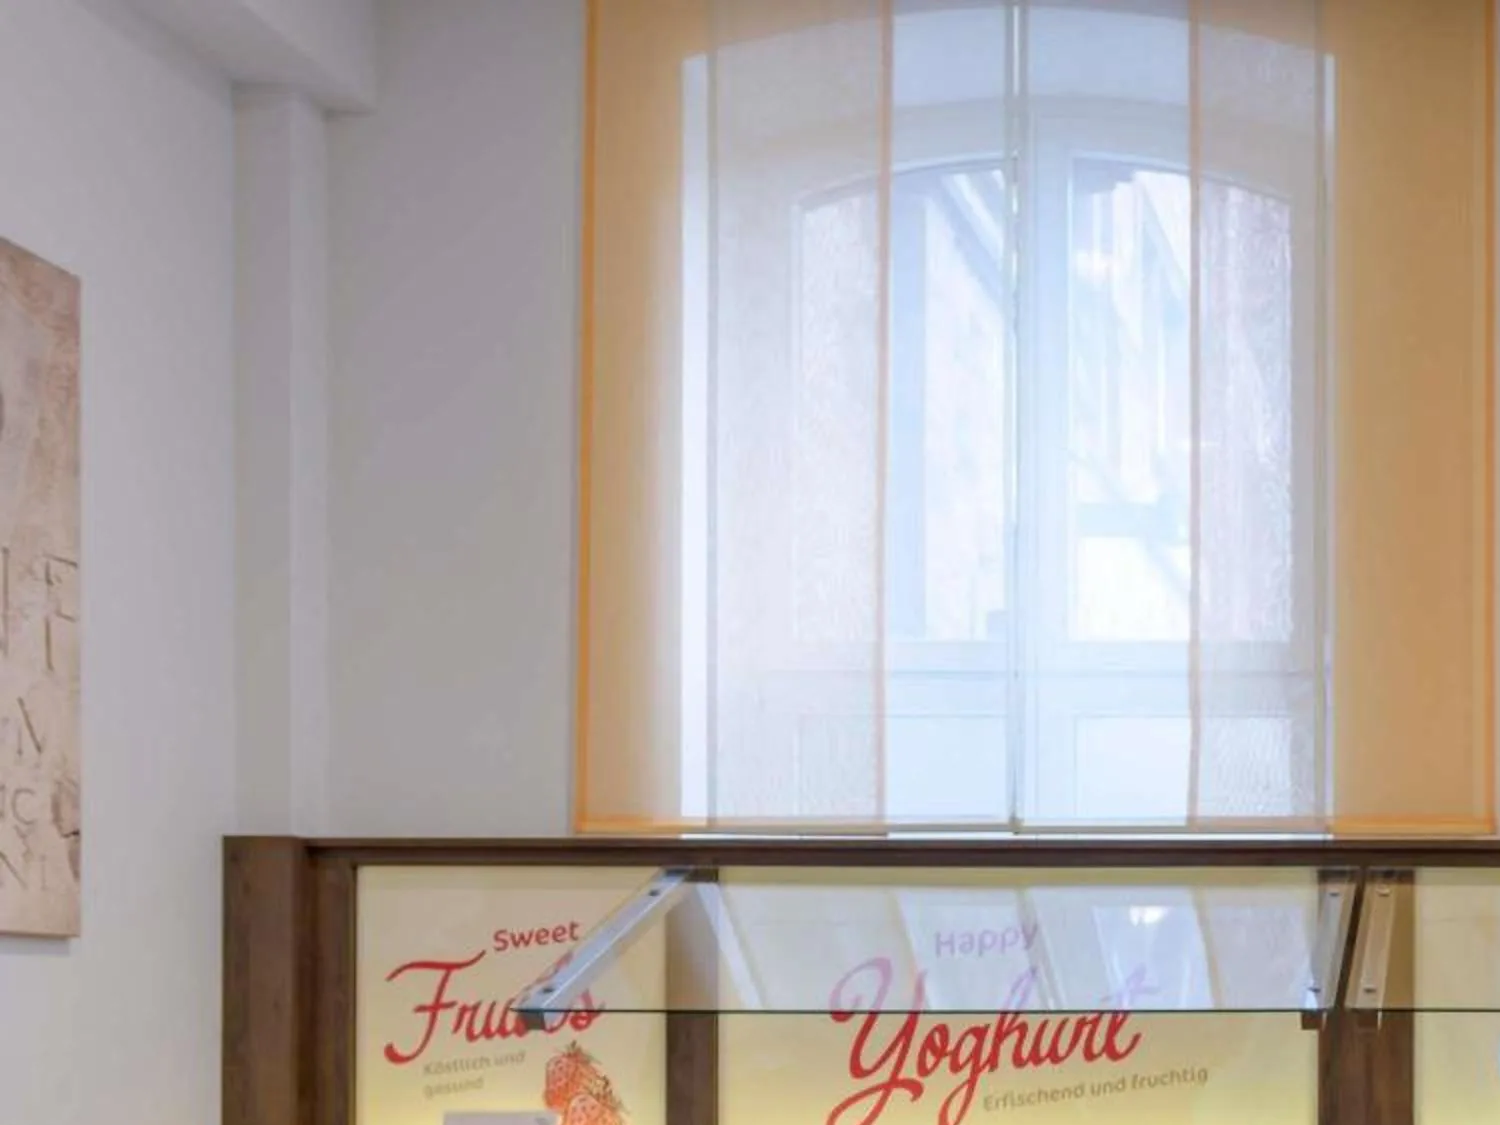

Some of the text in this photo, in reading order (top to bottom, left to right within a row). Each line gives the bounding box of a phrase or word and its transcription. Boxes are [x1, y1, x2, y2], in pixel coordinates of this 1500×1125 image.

[493, 921, 580, 951] Sweet
[935, 921, 1038, 958] Happy
[1090, 1077, 1127, 1097] und
[1131, 1066, 1210, 1091] fruchtig
